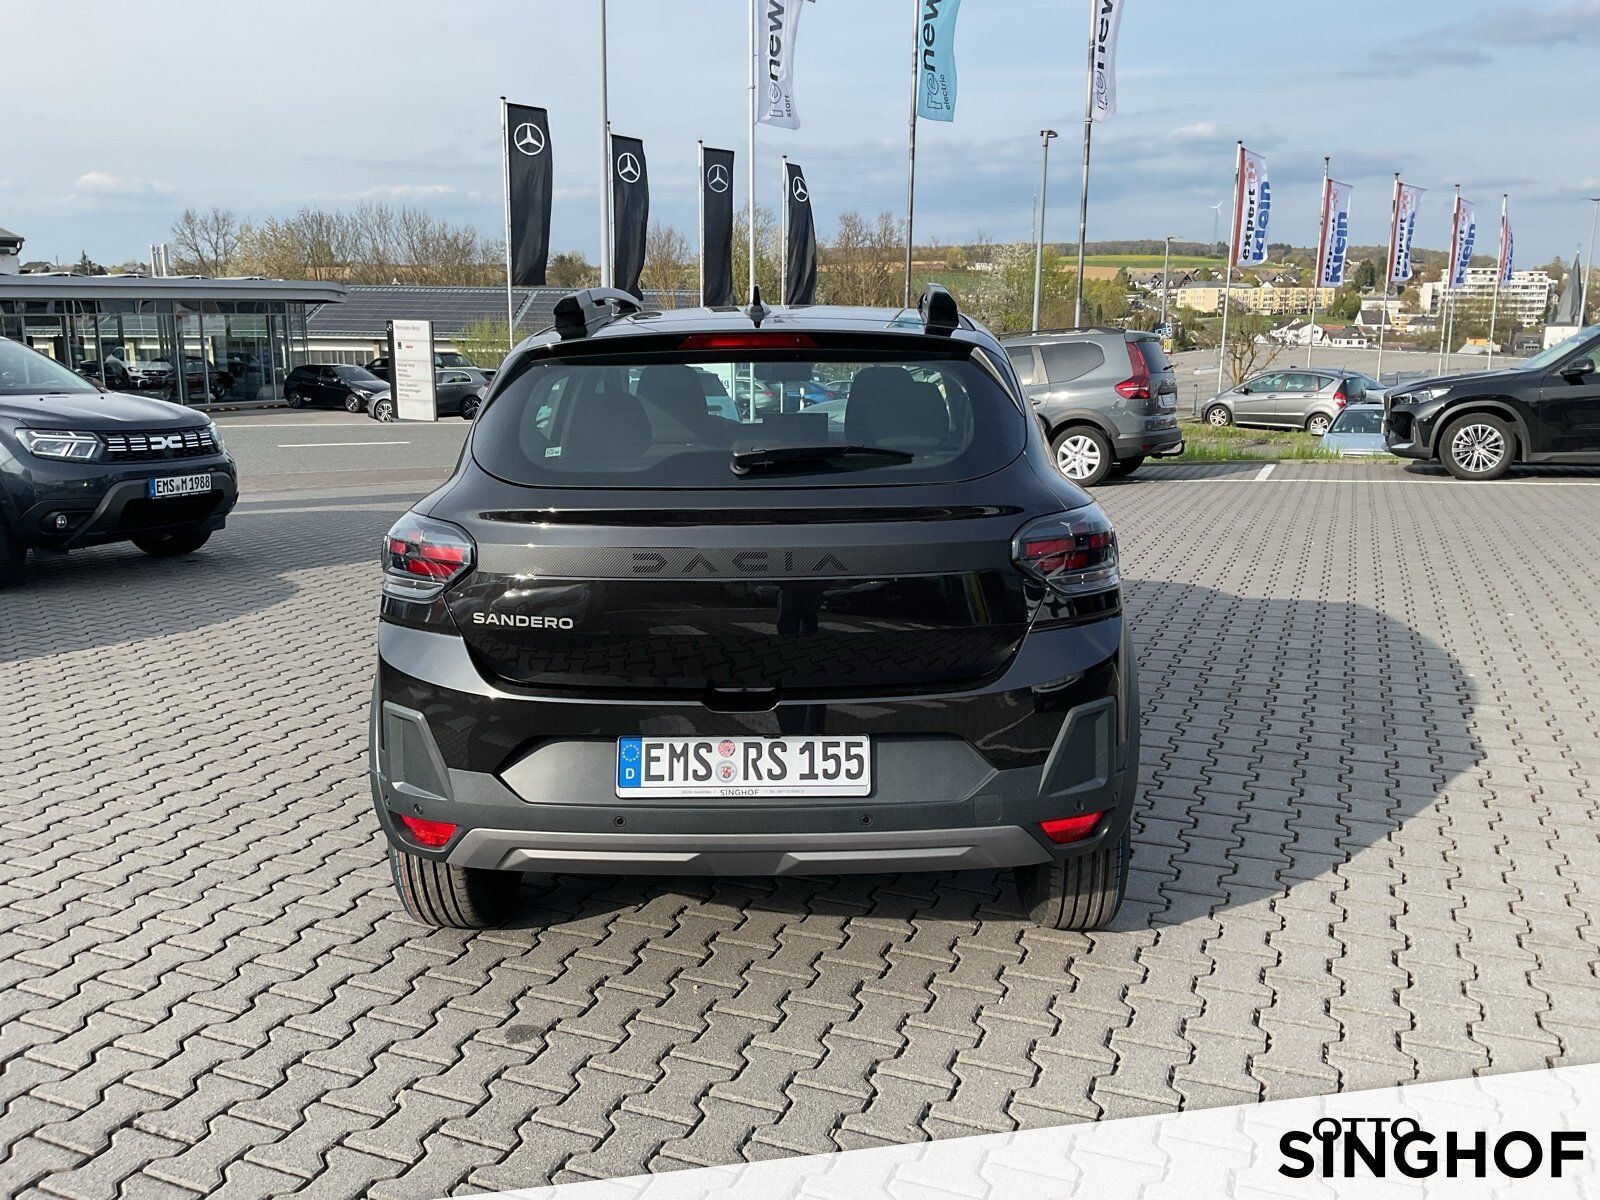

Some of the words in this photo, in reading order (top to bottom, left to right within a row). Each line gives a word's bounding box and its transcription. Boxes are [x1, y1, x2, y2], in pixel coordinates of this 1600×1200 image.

[156, 479, 175, 494] EMS
[181, 477, 188, 491] M
[189, 475, 210, 490] 1988
[632, 551, 849, 574] DACIA
[472, 611, 574, 631] SANDERO
[644, 742, 713, 782] EMS
[742, 741, 788, 781] RS
[798, 741, 866, 781] 155
[625, 767, 635, 780] D
